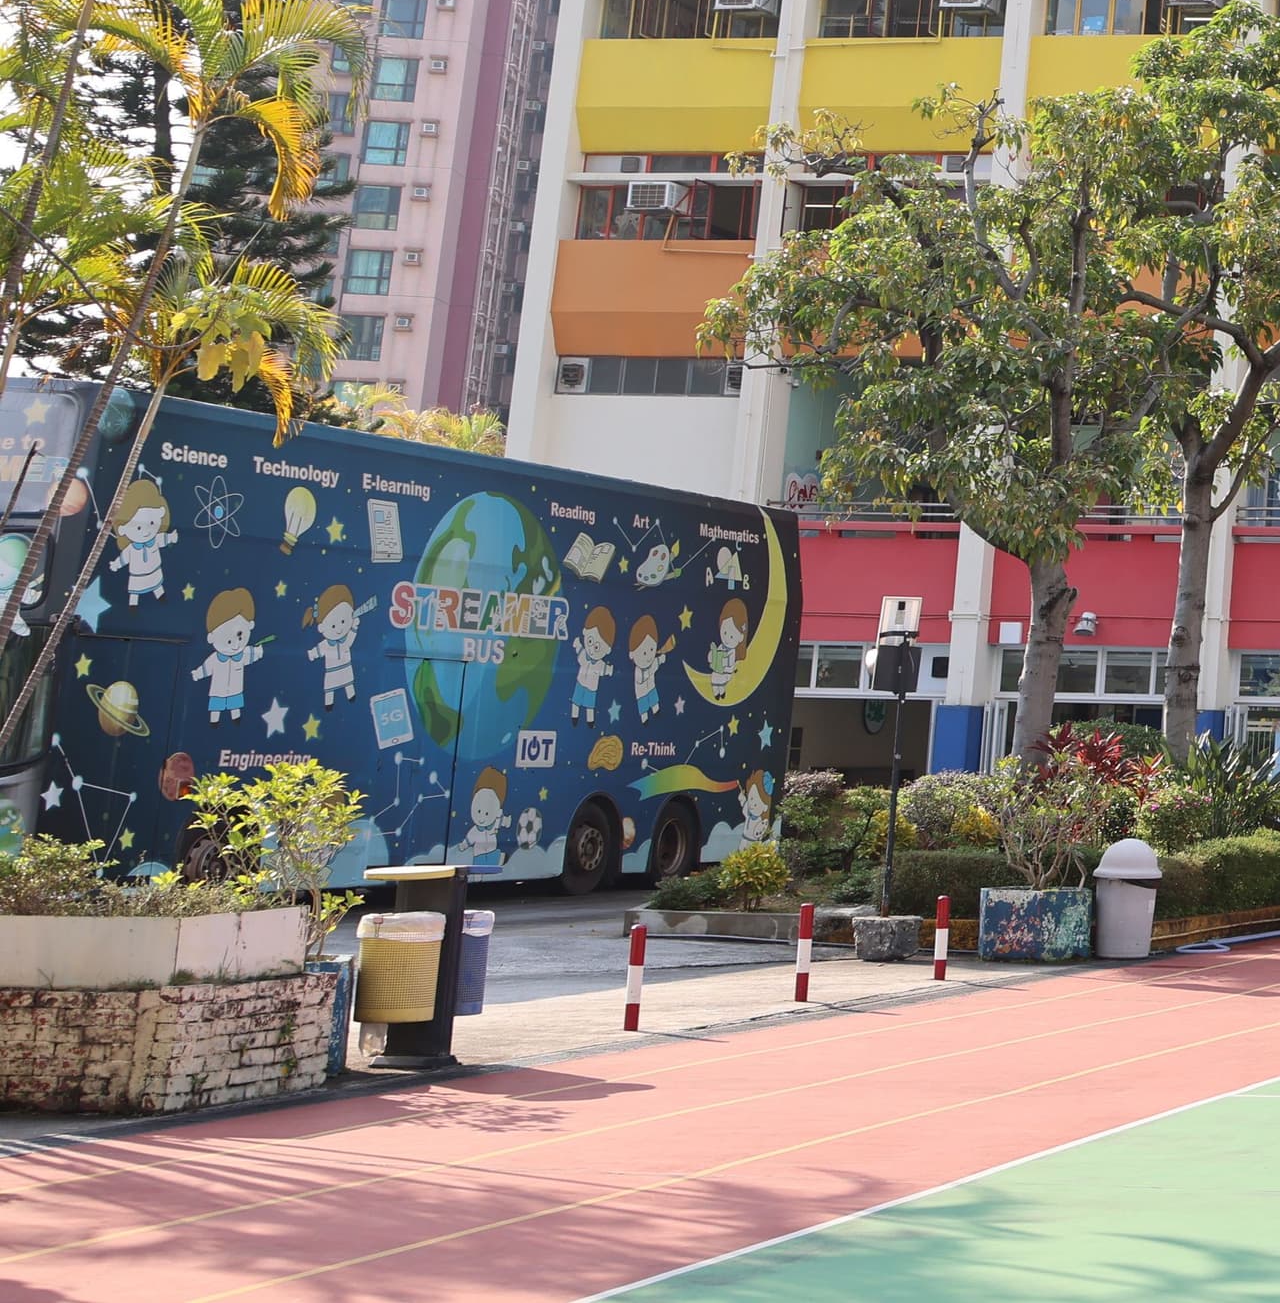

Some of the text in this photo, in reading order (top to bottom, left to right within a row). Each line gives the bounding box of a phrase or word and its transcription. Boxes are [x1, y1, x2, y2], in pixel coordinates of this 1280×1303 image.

[160, 441, 228, 469] Science
[253, 455, 340, 489] Technology
[361, 472, 431, 502] E-learning
[550, 501, 596, 526] Reading
[633, 513, 650, 530] Art
[699, 522, 760, 545] Mathematics
[705, 566, 751, 591] A B
[389, 580, 570, 641] STREAMER
[462, 637, 506, 665] BUS
[380, 707, 405, 727] 5G
[218, 749, 312, 772] Engineering
[631, 741, 677, 757] Re-Think
